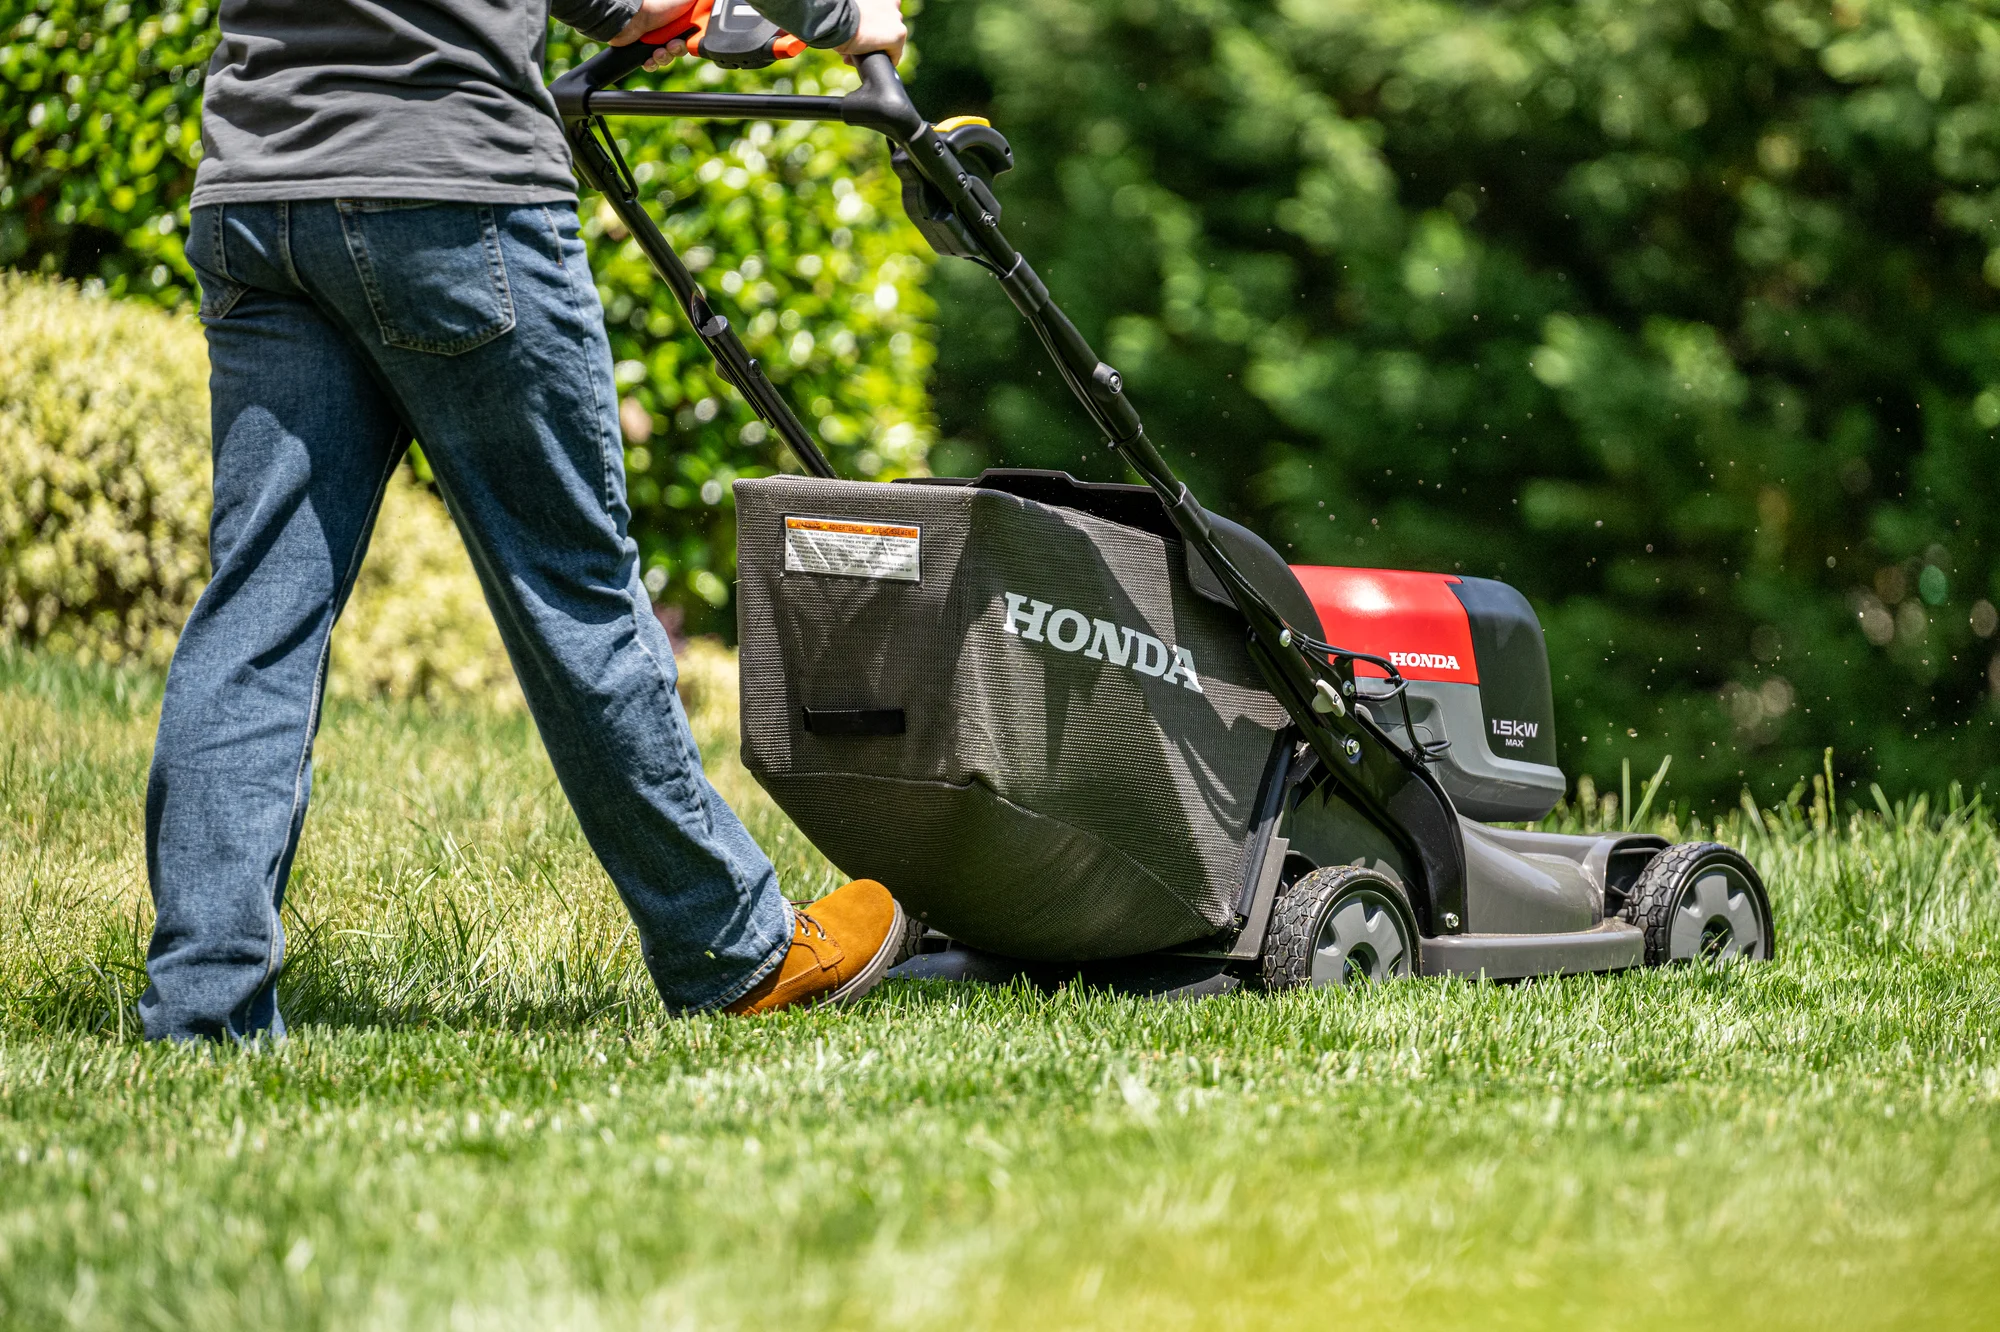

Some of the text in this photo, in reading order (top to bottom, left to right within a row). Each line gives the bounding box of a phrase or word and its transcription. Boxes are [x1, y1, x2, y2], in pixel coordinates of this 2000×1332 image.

[1003, 591, 1203, 694] HONDA
[1388, 652, 1461, 670] HONDA
[1491, 718, 1539, 738] 1.5kW
[1505, 738, 1524, 748] MAX
